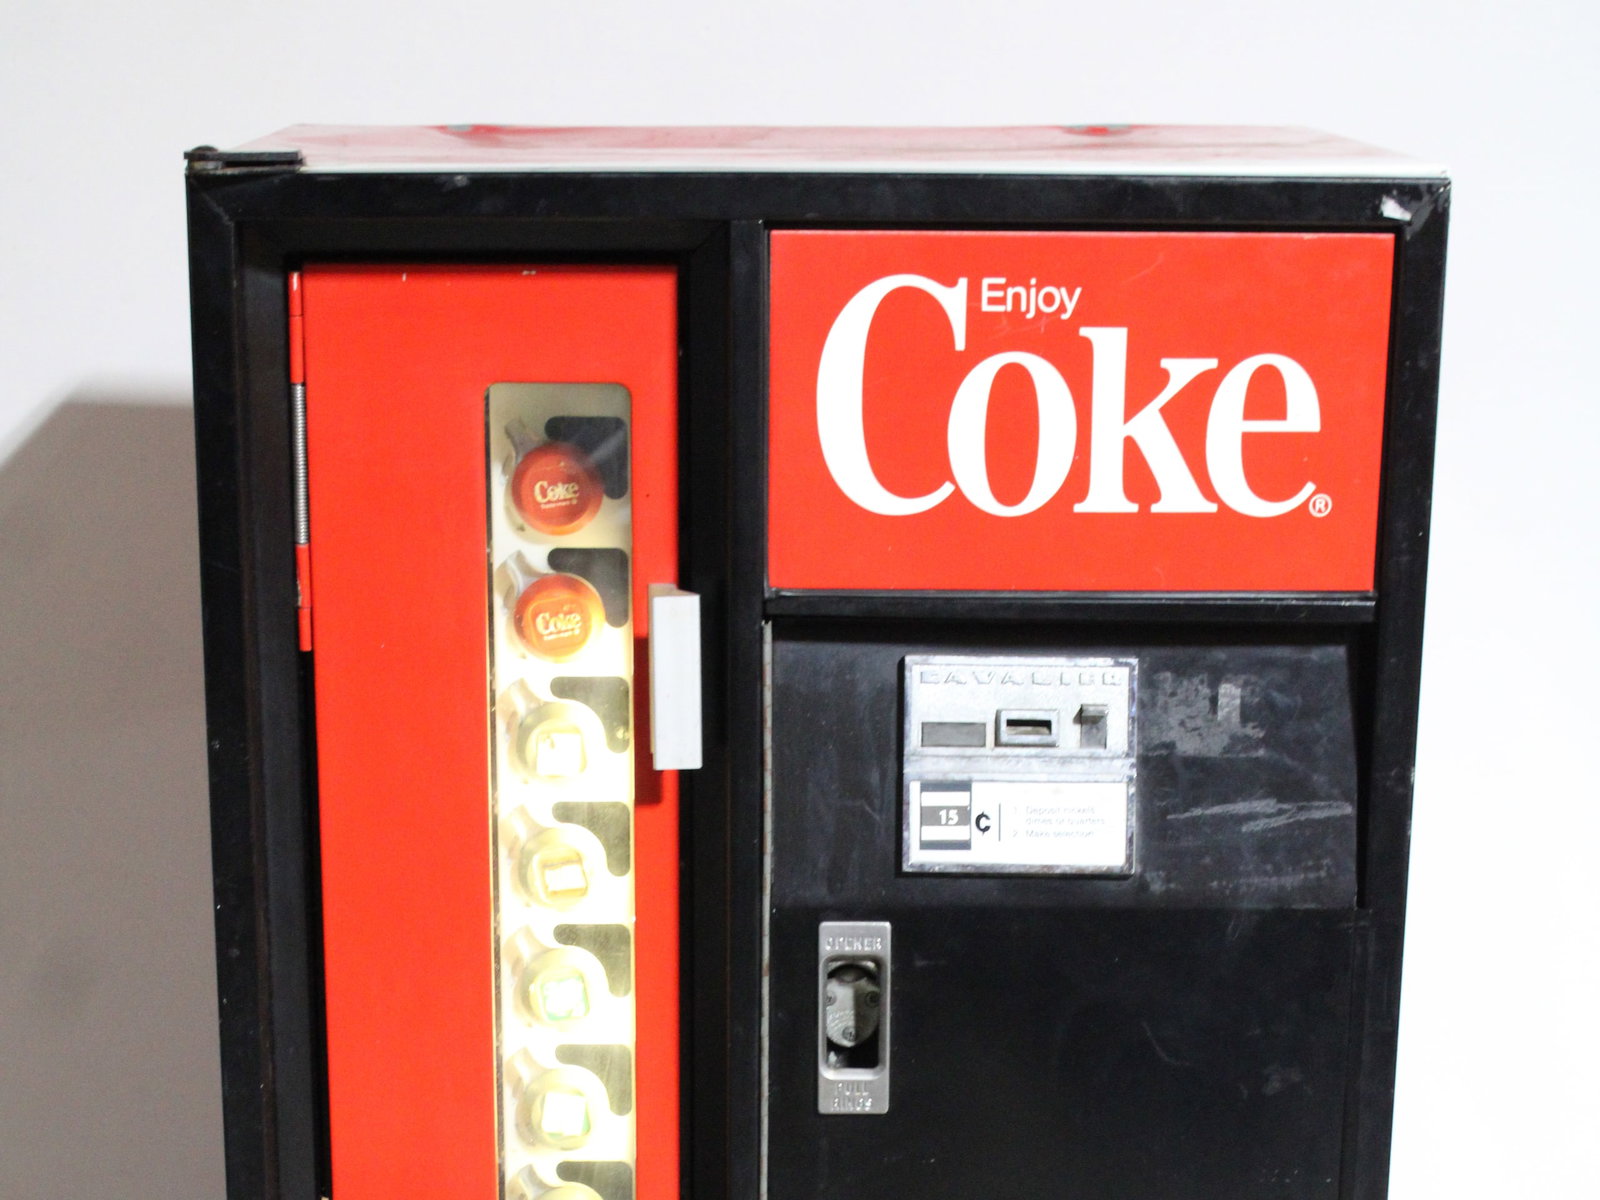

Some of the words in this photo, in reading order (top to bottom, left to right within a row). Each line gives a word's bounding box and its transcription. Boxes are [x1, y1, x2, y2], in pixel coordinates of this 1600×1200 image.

[981, 277, 1082, 319] Enjoy
[534, 480, 579, 504] Coke
[536, 612, 582, 635] Coke
[920, 671, 1122, 686] CAVALIER
[938, 809, 959, 825] 15
[825, 937, 882, 951] OPENER
